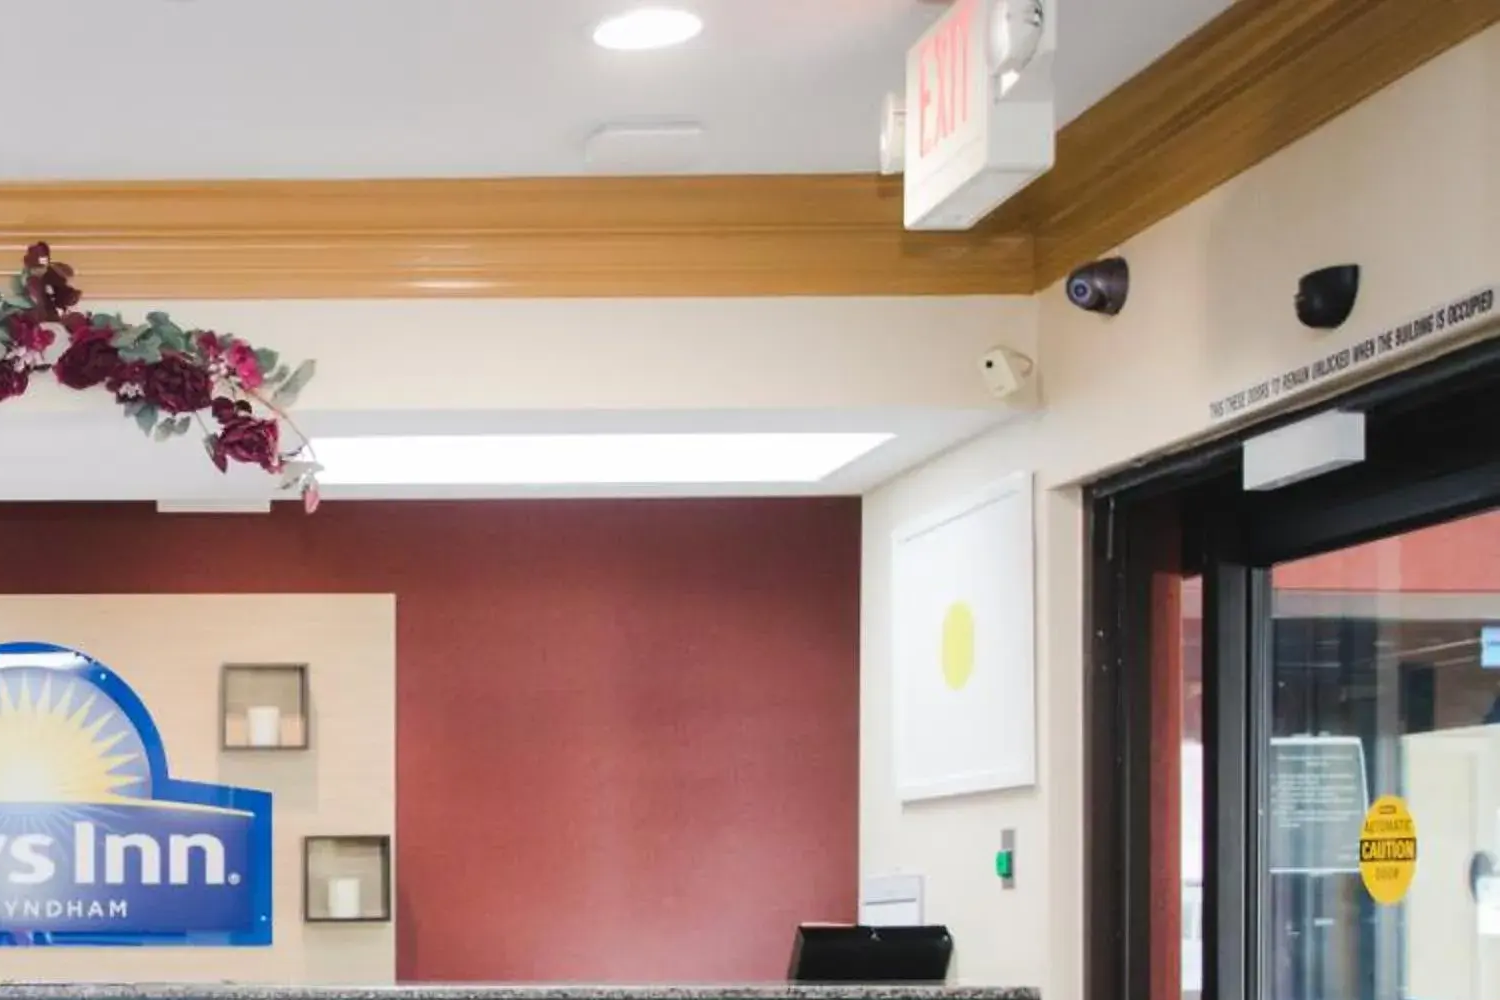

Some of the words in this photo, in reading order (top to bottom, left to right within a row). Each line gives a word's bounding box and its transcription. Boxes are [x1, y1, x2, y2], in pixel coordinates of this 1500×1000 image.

[919, 4, 974, 158] EXIT
[1283, 366, 1309, 389] REMAIN
[1312, 349, 1350, 379] UNLOCKED
[1353, 338, 1375, 362] WHEN
[1378, 330, 1392, 352] THE
[1395, 313, 1434, 346] BUILDING
[1436, 309, 1445, 329] IS
[1448, 289, 1494, 326] OCCUPIED
[74, 821, 226, 885] Inn
[1362, 840, 1415, 860] CAUTION
[1363, 819, 1413, 833] AUTOMATIC
